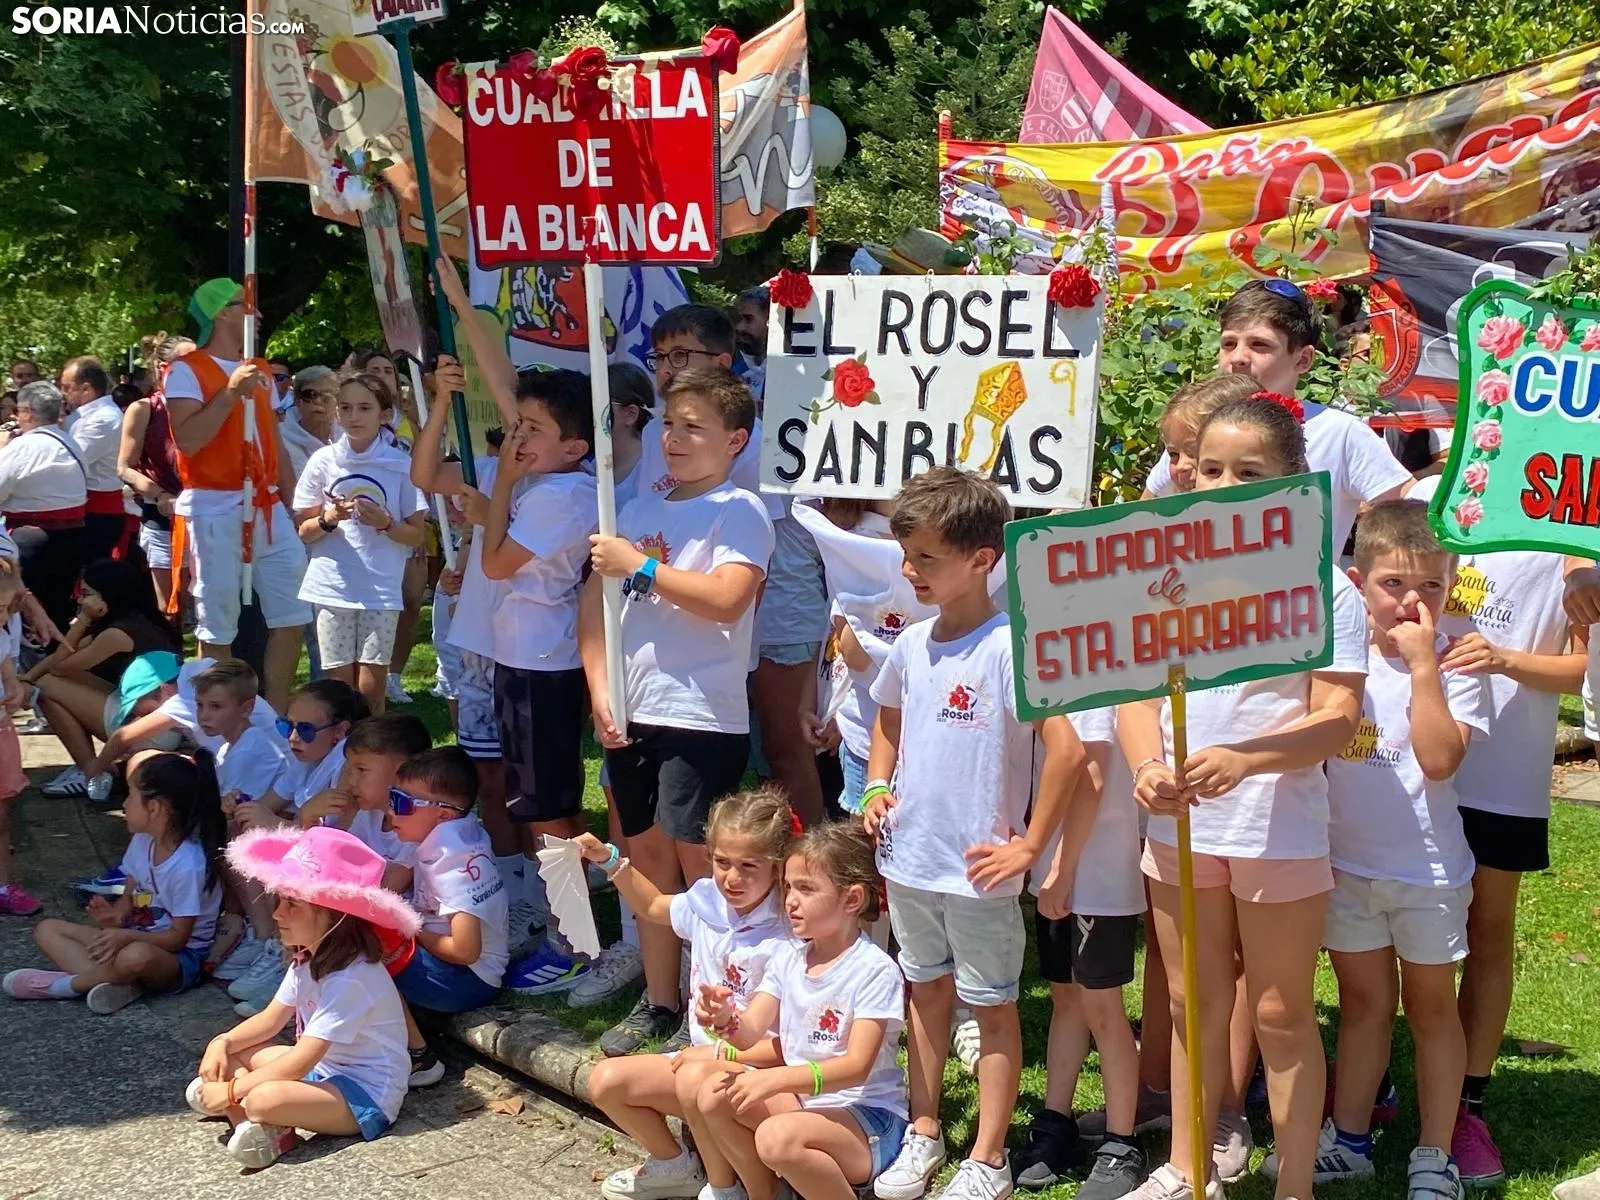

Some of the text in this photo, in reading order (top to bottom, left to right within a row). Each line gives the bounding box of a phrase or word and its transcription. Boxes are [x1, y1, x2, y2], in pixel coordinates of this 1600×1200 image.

[467, 67, 708, 127] CUADILLA
[557, 138, 614, 188] DE
[475, 201, 712, 253] LA BLANCA
[782, 288, 1082, 359] EL ROSEL
[909, 364, 941, 412] Y
[774, 417, 888, 487] SAN
[1046, 505, 1292, 585] CUADRILLA
[1147, 566, 1187, 605] de
[1443, 588, 1513, 624] Bárbara
[1035, 584, 1317, 681] STA. BARBARA
[941, 708, 974, 721] Rosel
[1336, 739, 1401, 763] Bárbara
